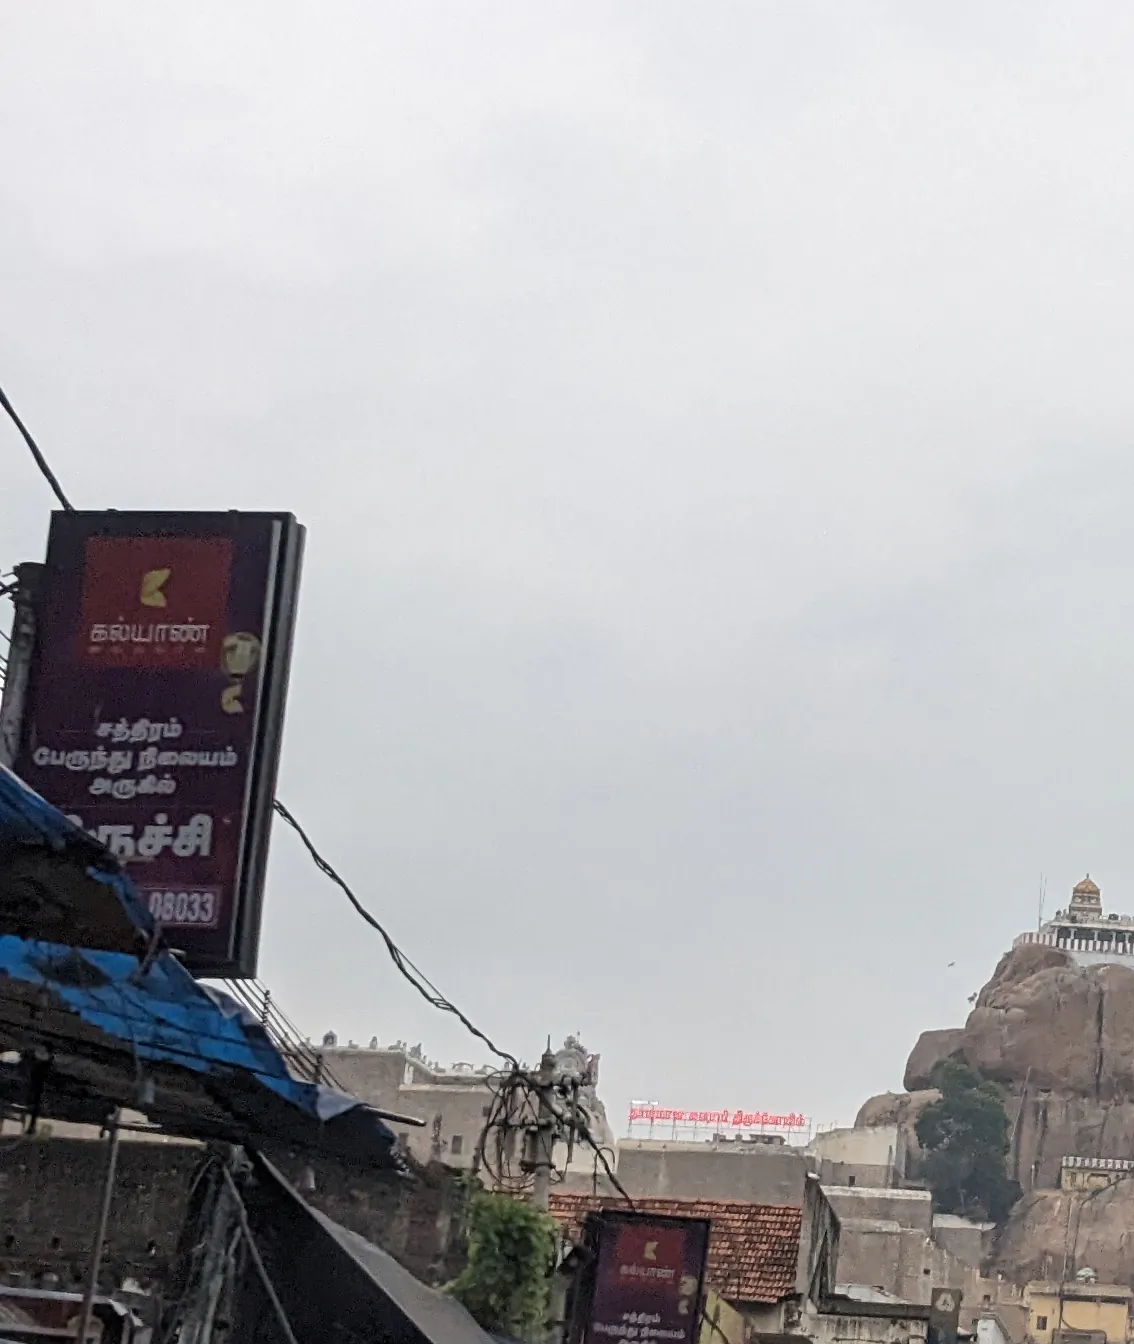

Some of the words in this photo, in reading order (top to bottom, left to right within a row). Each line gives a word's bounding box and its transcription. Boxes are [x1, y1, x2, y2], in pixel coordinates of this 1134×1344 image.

[90, 616, 210, 643] கல்யாண்
[96, 716, 183, 742] சத்திரம்
[33, 745, 132, 774] பேருந்து
[137, 745, 238, 771] நிலையம்
[89, 773, 177, 799] அருகில்
